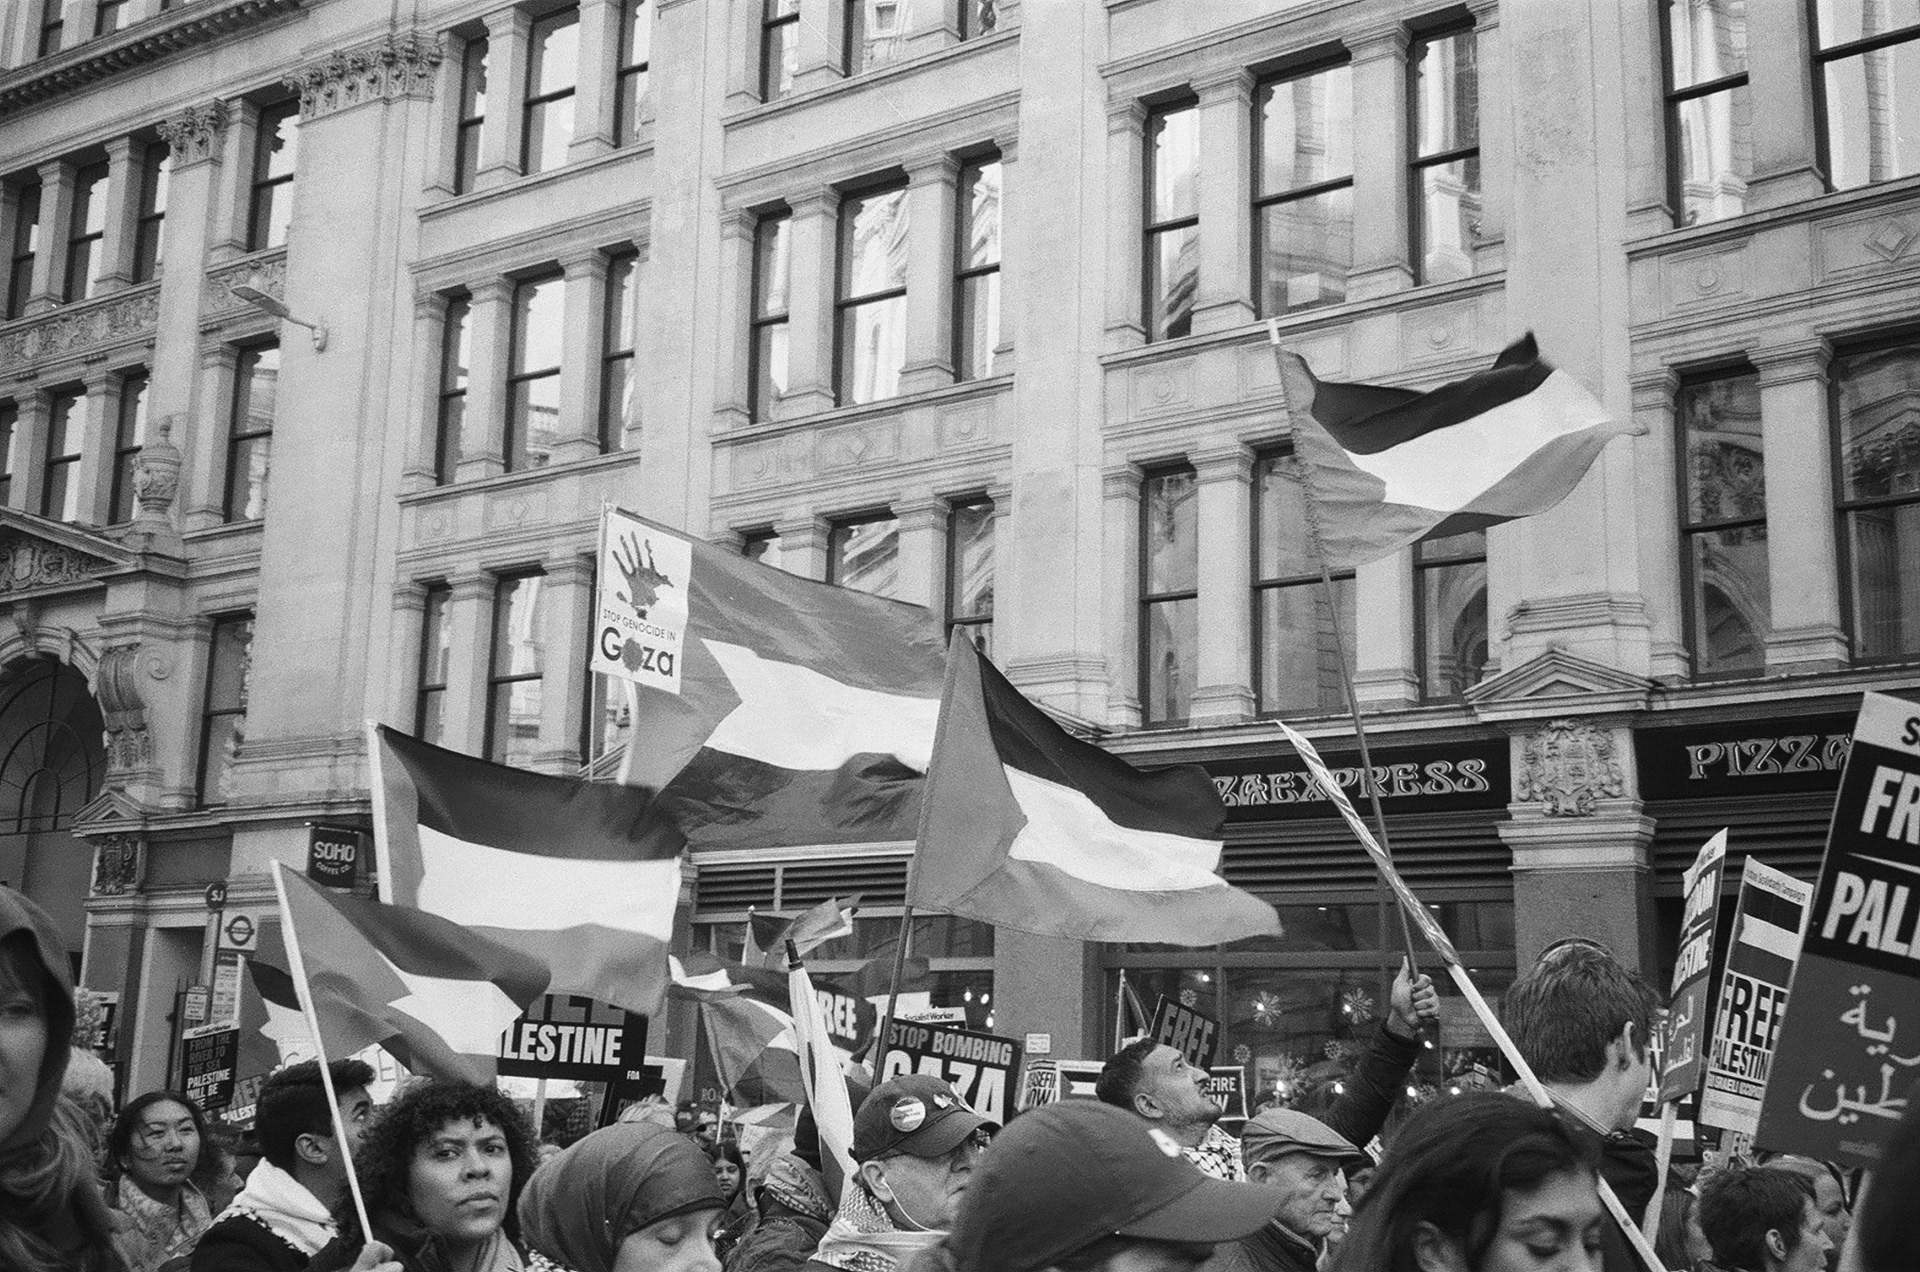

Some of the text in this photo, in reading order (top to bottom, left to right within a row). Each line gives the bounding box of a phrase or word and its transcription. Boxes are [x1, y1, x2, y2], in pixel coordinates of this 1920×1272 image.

[603, 609, 677, 642] STOP GENOCIDE IN
[1901, 717, 1920, 746] S
[313, 841, 355, 862] SOHO
[815, 988, 858, 1041] REE
[930, 1011, 954, 1021] Worker
[189, 1033, 231, 1051] FROM THE
[500, 1022, 624, 1066] LESTINE
[889, 1023, 929, 1050] STOP
[932, 1031, 1013, 1066] BOMBING
[1158, 1002, 1215, 1068] FREE
[188, 1046, 226, 1063] RIVER TO
[188, 1059, 221, 1076] THE SEA
[187, 1068, 231, 1089] PALESTINE
[1206, 1077, 1237, 1092] FIRE
[186, 1083, 219, 1100] WILL BE
